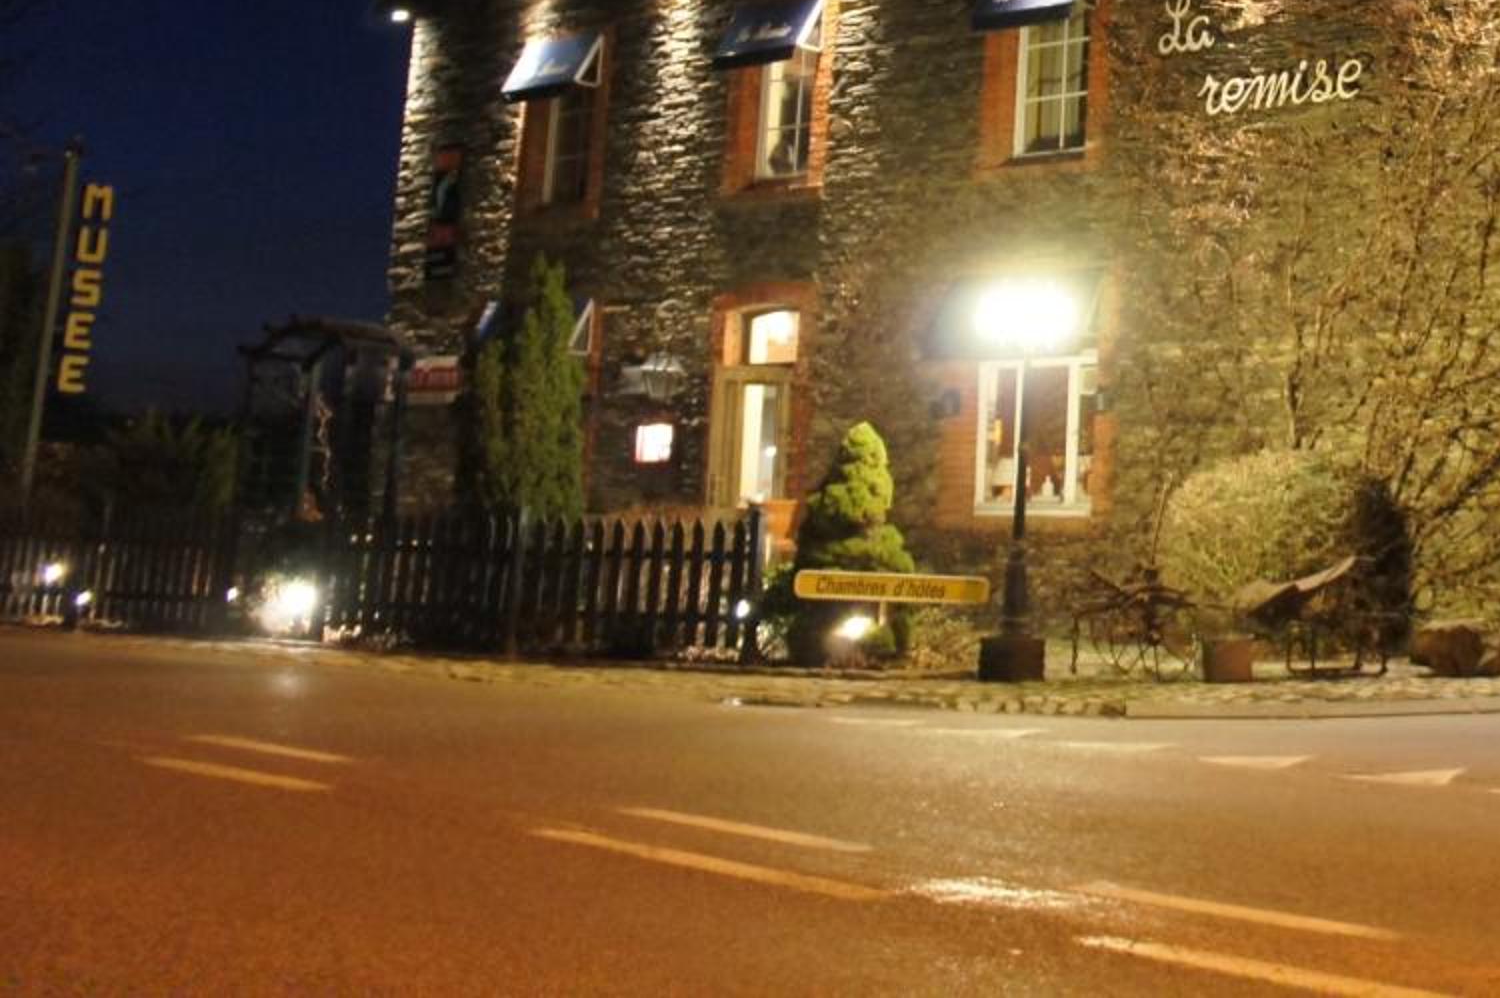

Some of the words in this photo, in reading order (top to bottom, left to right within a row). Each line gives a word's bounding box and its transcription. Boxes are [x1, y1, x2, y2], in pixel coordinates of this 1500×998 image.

[1196, 57, 1363, 116] remise
[57, 182, 114, 394] MUSEE
[815, 576, 886, 596] Chambres
